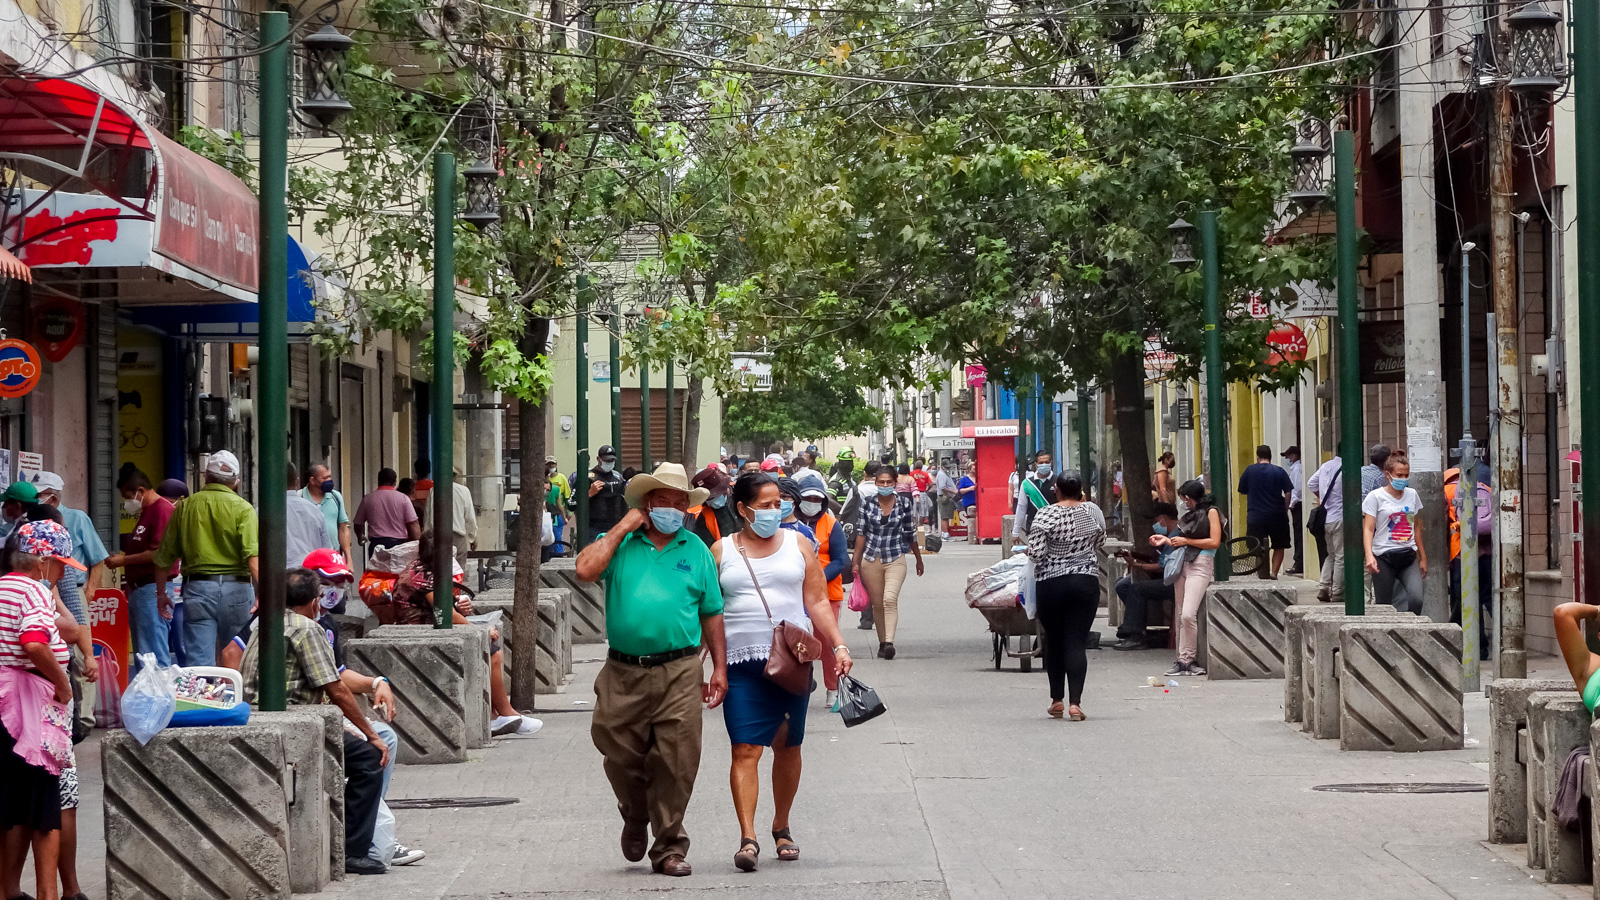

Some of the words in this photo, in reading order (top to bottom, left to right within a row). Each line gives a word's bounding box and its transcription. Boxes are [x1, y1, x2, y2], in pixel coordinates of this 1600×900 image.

[986, 426, 1017, 435] Heraldo
[942, 439, 951, 447] La
[952, 439, 975, 447] Tribun
[88, 597, 119, 611] ega
[90, 608, 117, 627] quí
